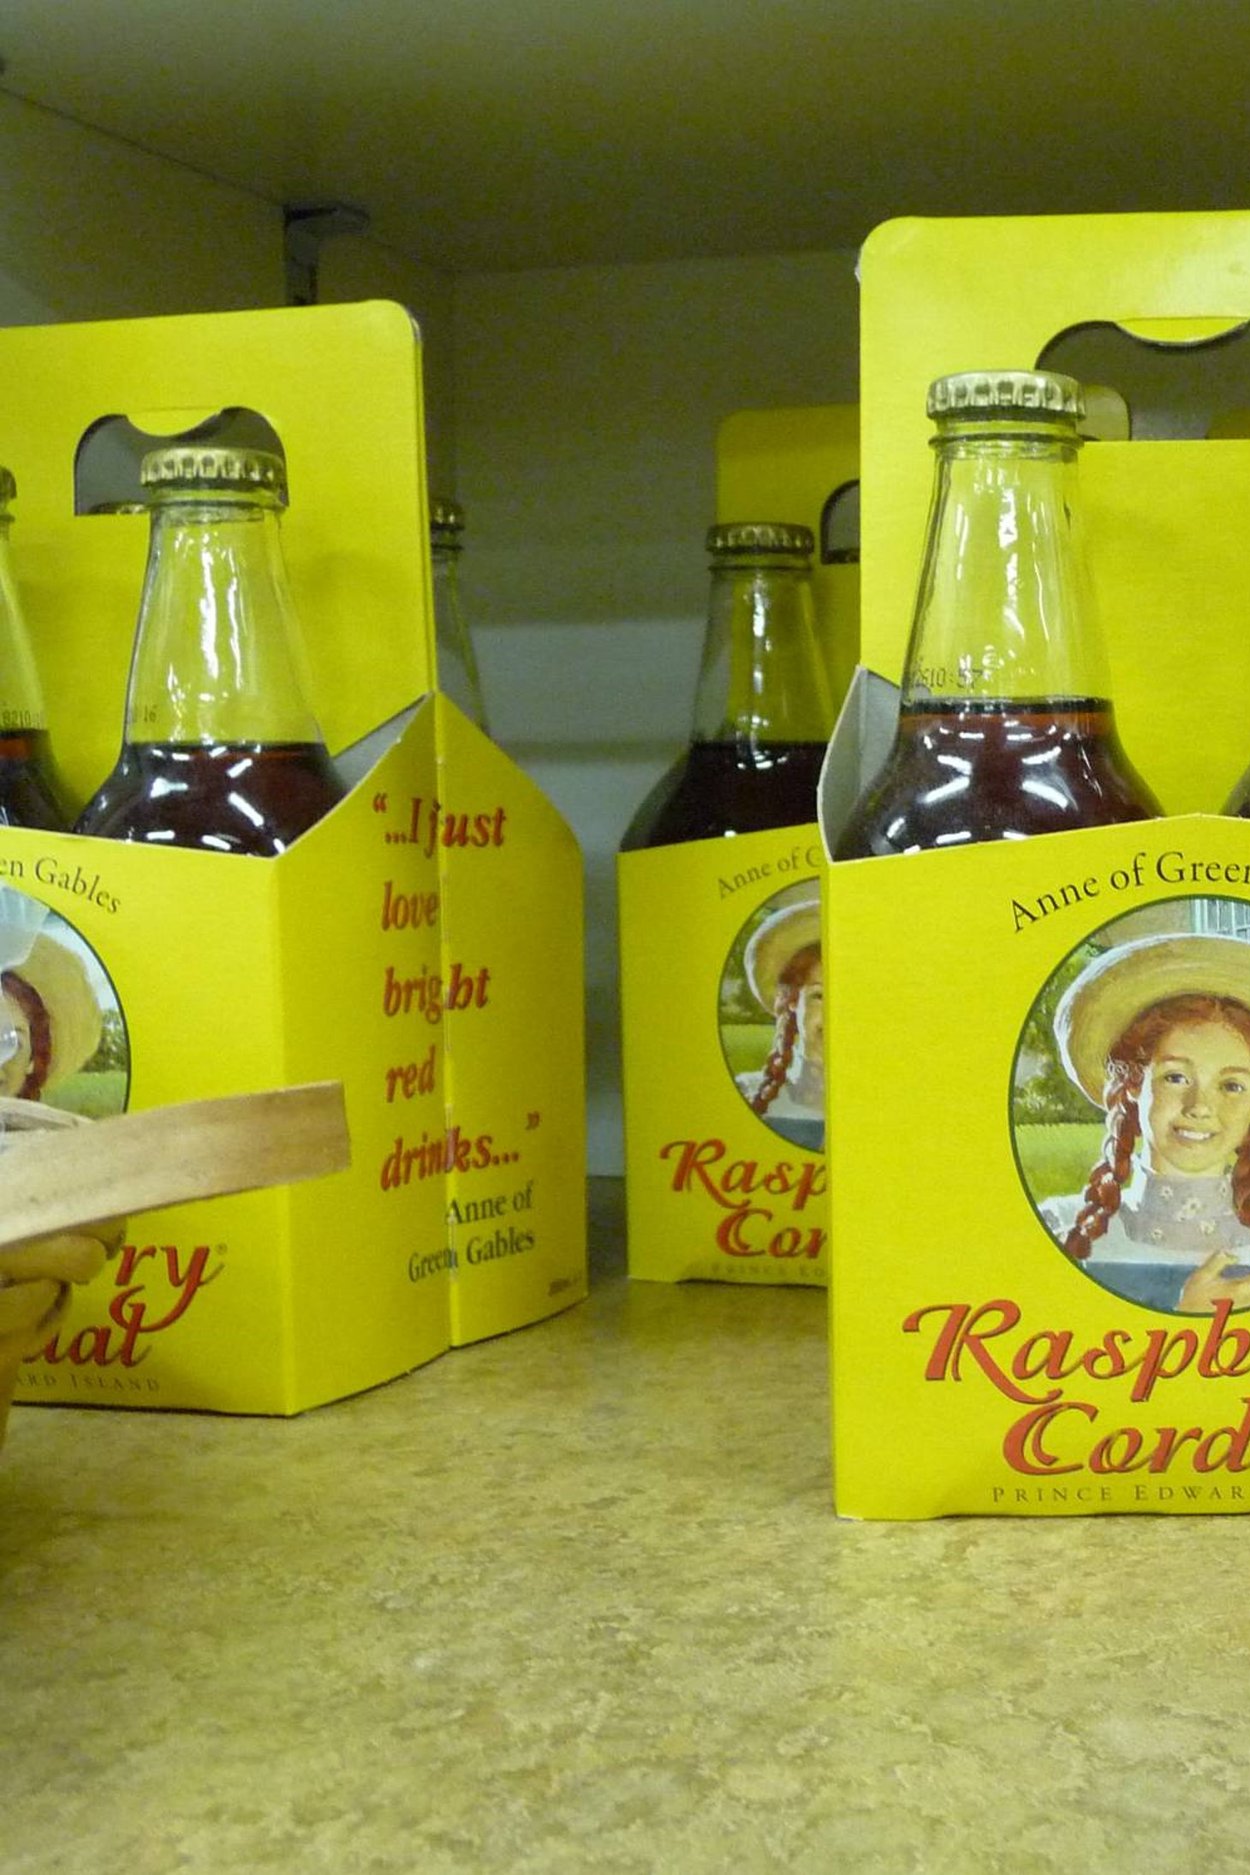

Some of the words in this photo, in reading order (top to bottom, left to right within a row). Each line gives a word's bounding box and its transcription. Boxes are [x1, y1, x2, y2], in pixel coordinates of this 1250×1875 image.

[423, 797, 506, 859] just
[35, 857, 121, 914] Gables
[718, 863, 774, 899] Anne
[777, 846, 801, 873] of
[1010, 875, 1101, 933] Anne
[1110, 851, 1146, 891] of
[381, 880, 440, 931] love
[382, 963, 492, 1025] bright
[385, 1044, 436, 1103] red
[446, 1195, 507, 1225] Anne
[512, 1179, 534, 1212] of
[408, 1247, 459, 1283] Green
[466, 1226, 535, 1265] Gables
[992, 1486, 1114, 1503] PRINCE
